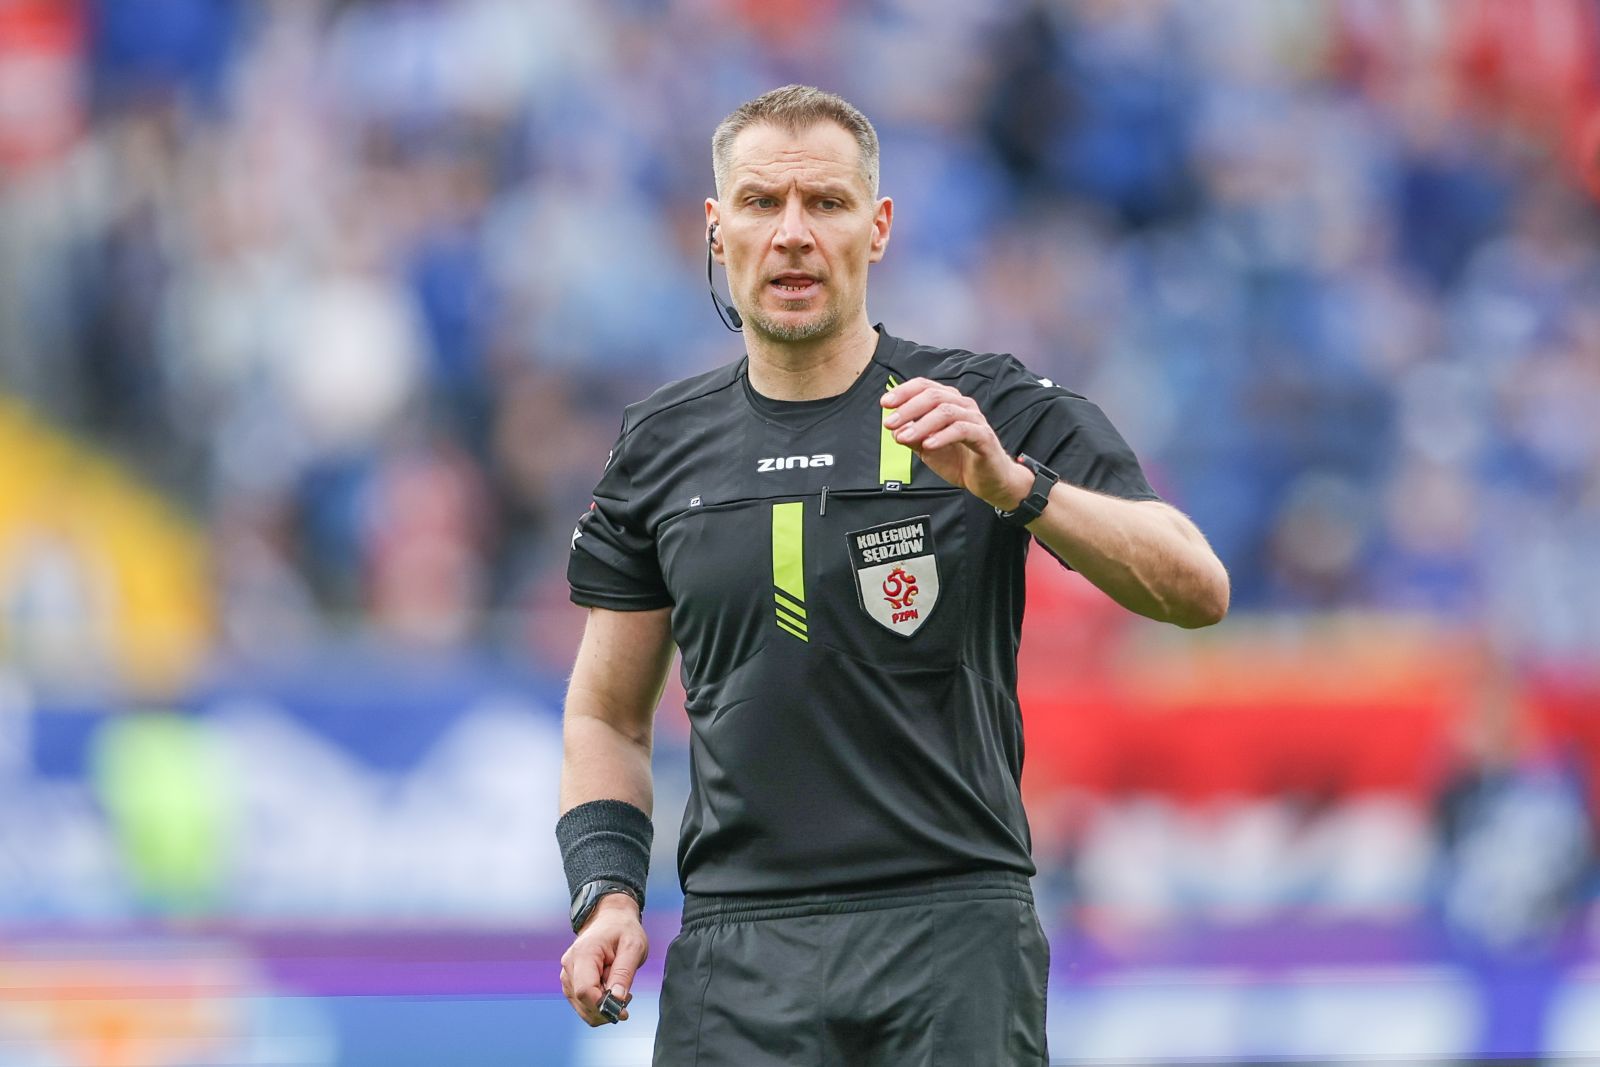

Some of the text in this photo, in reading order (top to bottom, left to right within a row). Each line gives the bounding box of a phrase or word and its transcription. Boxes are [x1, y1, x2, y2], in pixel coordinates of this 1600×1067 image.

[856, 523, 925, 549] KOLEGIUM
[862, 538, 923, 563] SĘDZIÓW
[891, 609, 919, 624] PZPN
